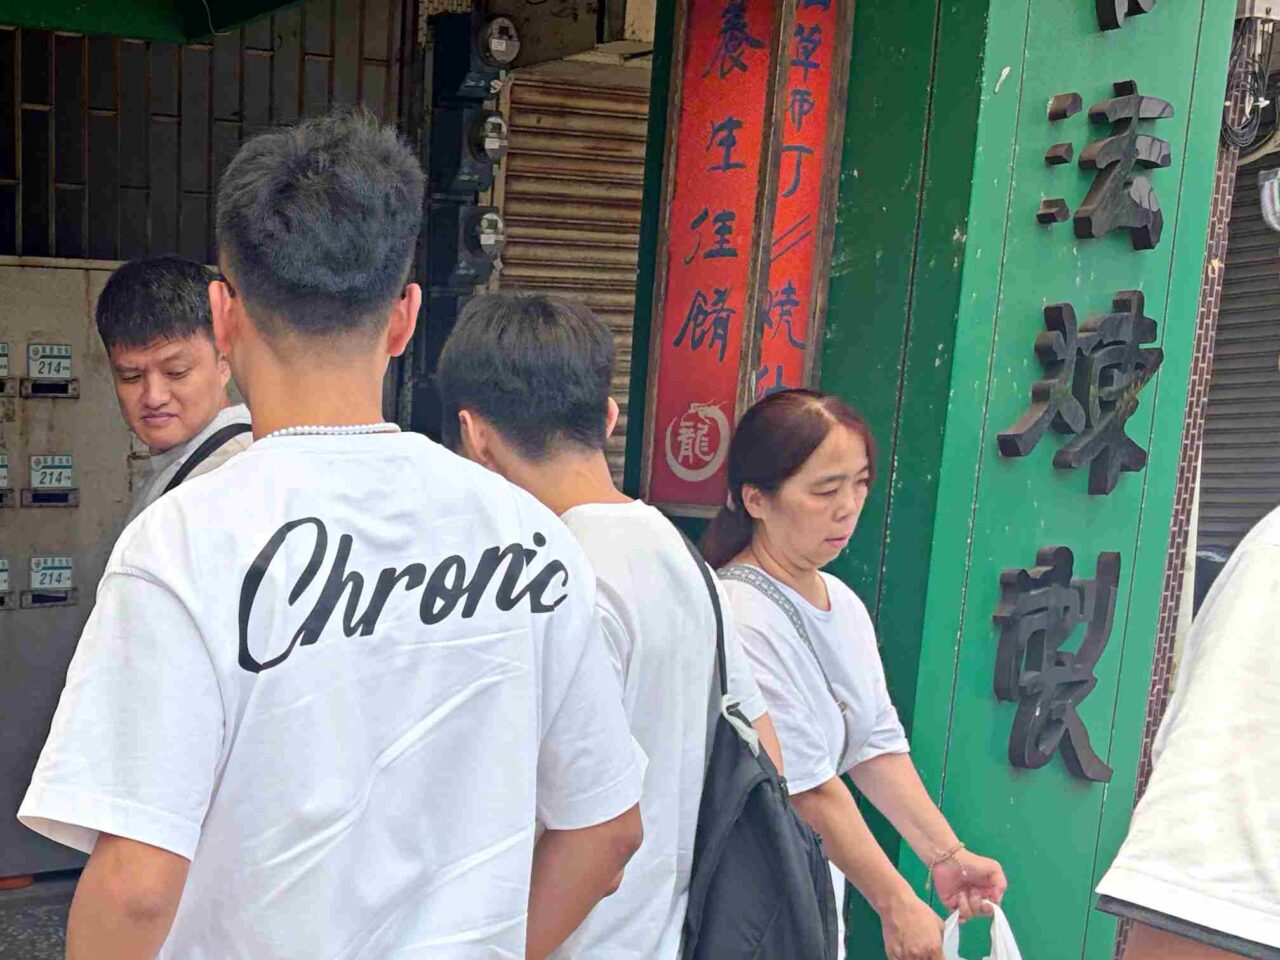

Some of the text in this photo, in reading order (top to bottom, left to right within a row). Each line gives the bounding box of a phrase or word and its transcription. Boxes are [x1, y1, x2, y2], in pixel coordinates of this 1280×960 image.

[781, 0, 832, 198] 草布丁
[38, 360, 61, 375] 214
[993, 0, 1175, 783] 法煉製
[39, 471, 63, 485] 214
[39, 572, 63, 585] 214
[238, 517, 569, 673] Chronic
